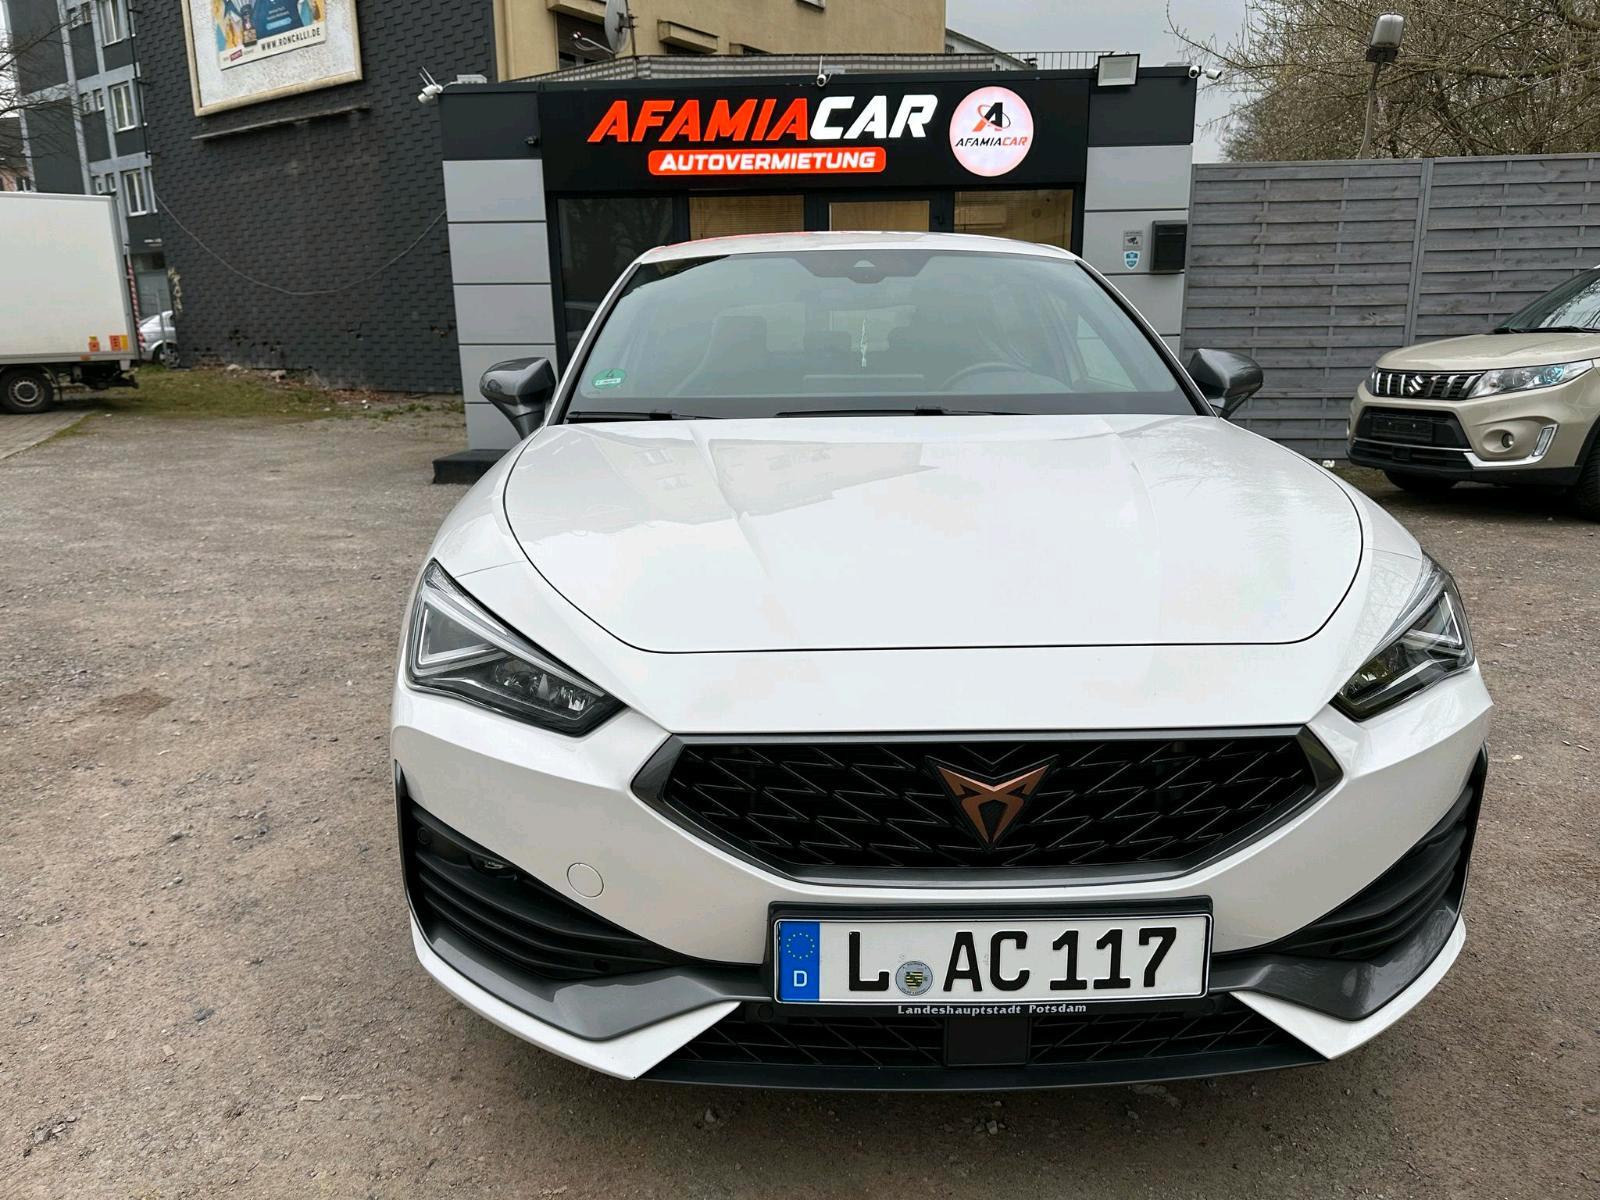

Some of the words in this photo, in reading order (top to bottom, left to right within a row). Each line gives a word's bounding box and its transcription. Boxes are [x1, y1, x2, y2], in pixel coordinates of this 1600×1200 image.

[261, 27, 321, 51] WWW.RONCALLI.DE
[586, 94, 939, 144] AFAMIACAR
[955, 136, 1028, 147] AFAMIACAR
[658, 149, 876, 172] AUTOVERMIETUNG
[848, 930, 890, 992] L
[942, 930, 1032, 993] AC
[1049, 926, 1178, 991] 117
[792, 970, 808, 988] D
[897, 1004, 1022, 1017] Landeshauptstadt
[1029, 1003, 1087, 1015] Potsdam
